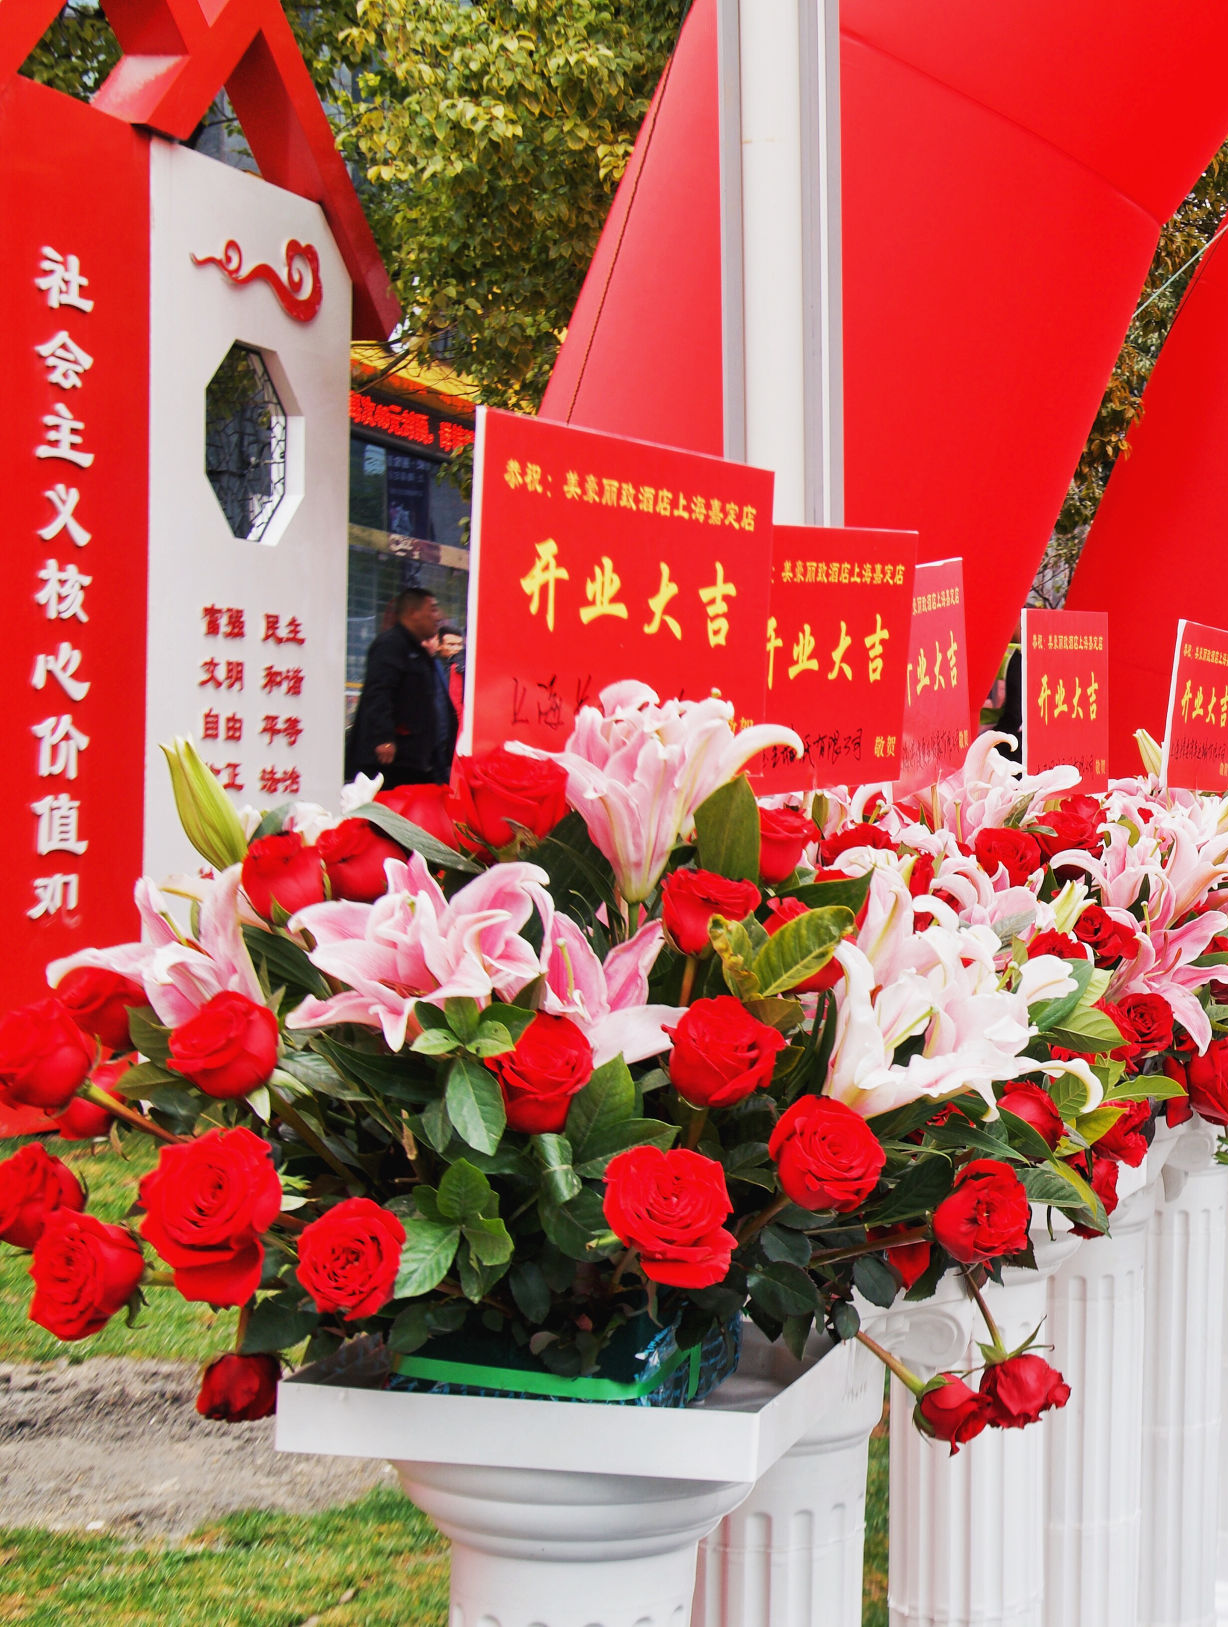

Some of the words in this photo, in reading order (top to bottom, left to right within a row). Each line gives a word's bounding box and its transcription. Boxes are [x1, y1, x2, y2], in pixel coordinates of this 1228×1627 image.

[26, 245, 95, 924] 社会主义核心价值观
[519, 537, 737, 649] 开业大吉
[201, 603, 246, 639] 富强
[260, 612, 306, 646] 民主
[766, 613, 890, 691] 开业大吉
[198, 656, 246, 692] 文明
[259, 663, 305, 696] 和谐
[1038, 671, 1099, 726] 开业大吉
[201, 707, 244, 742] 自由
[258, 714, 304, 747] 平等
[874, 735, 896, 758] 敬贺
[258, 764, 302, 795] 法治
